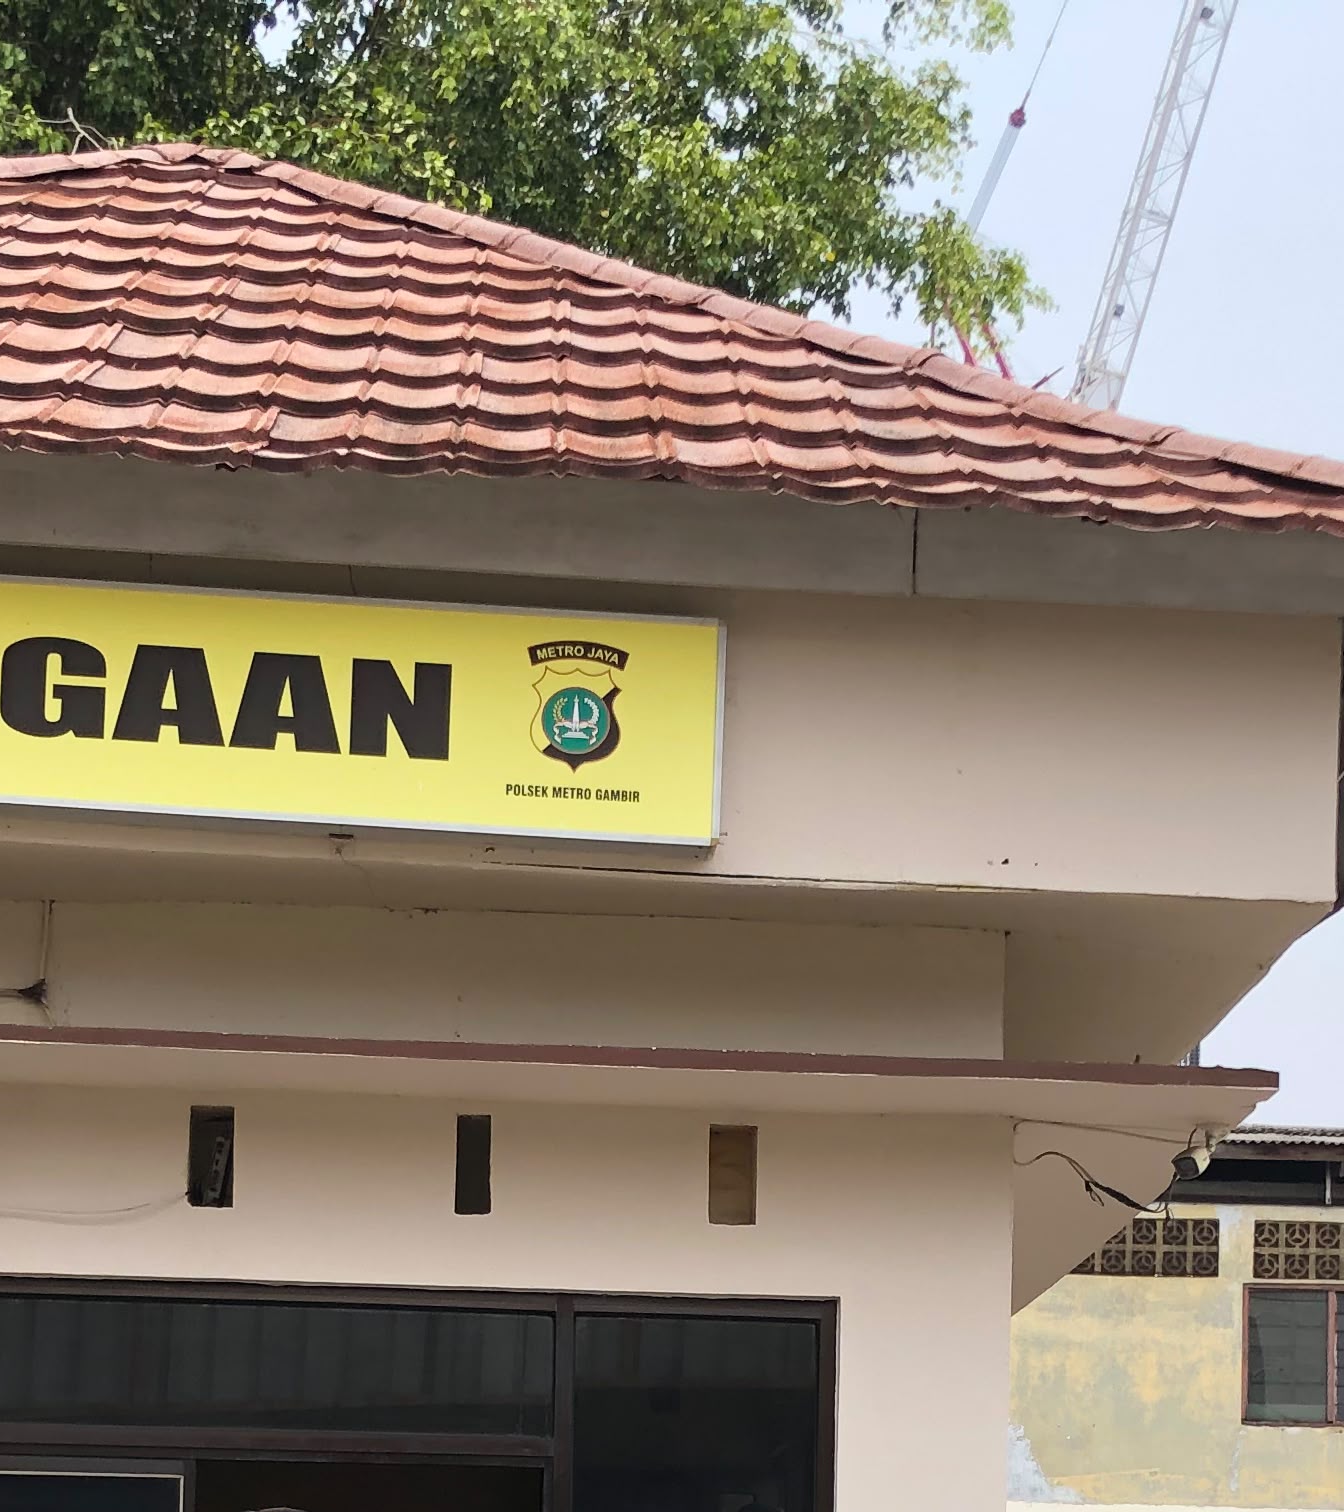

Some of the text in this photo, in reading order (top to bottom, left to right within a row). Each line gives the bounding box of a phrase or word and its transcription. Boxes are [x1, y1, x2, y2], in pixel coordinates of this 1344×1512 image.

[536, 645, 619, 664] METRO JAYA
[505, 784, 640, 803] POLSEK METRO GAMBIR
